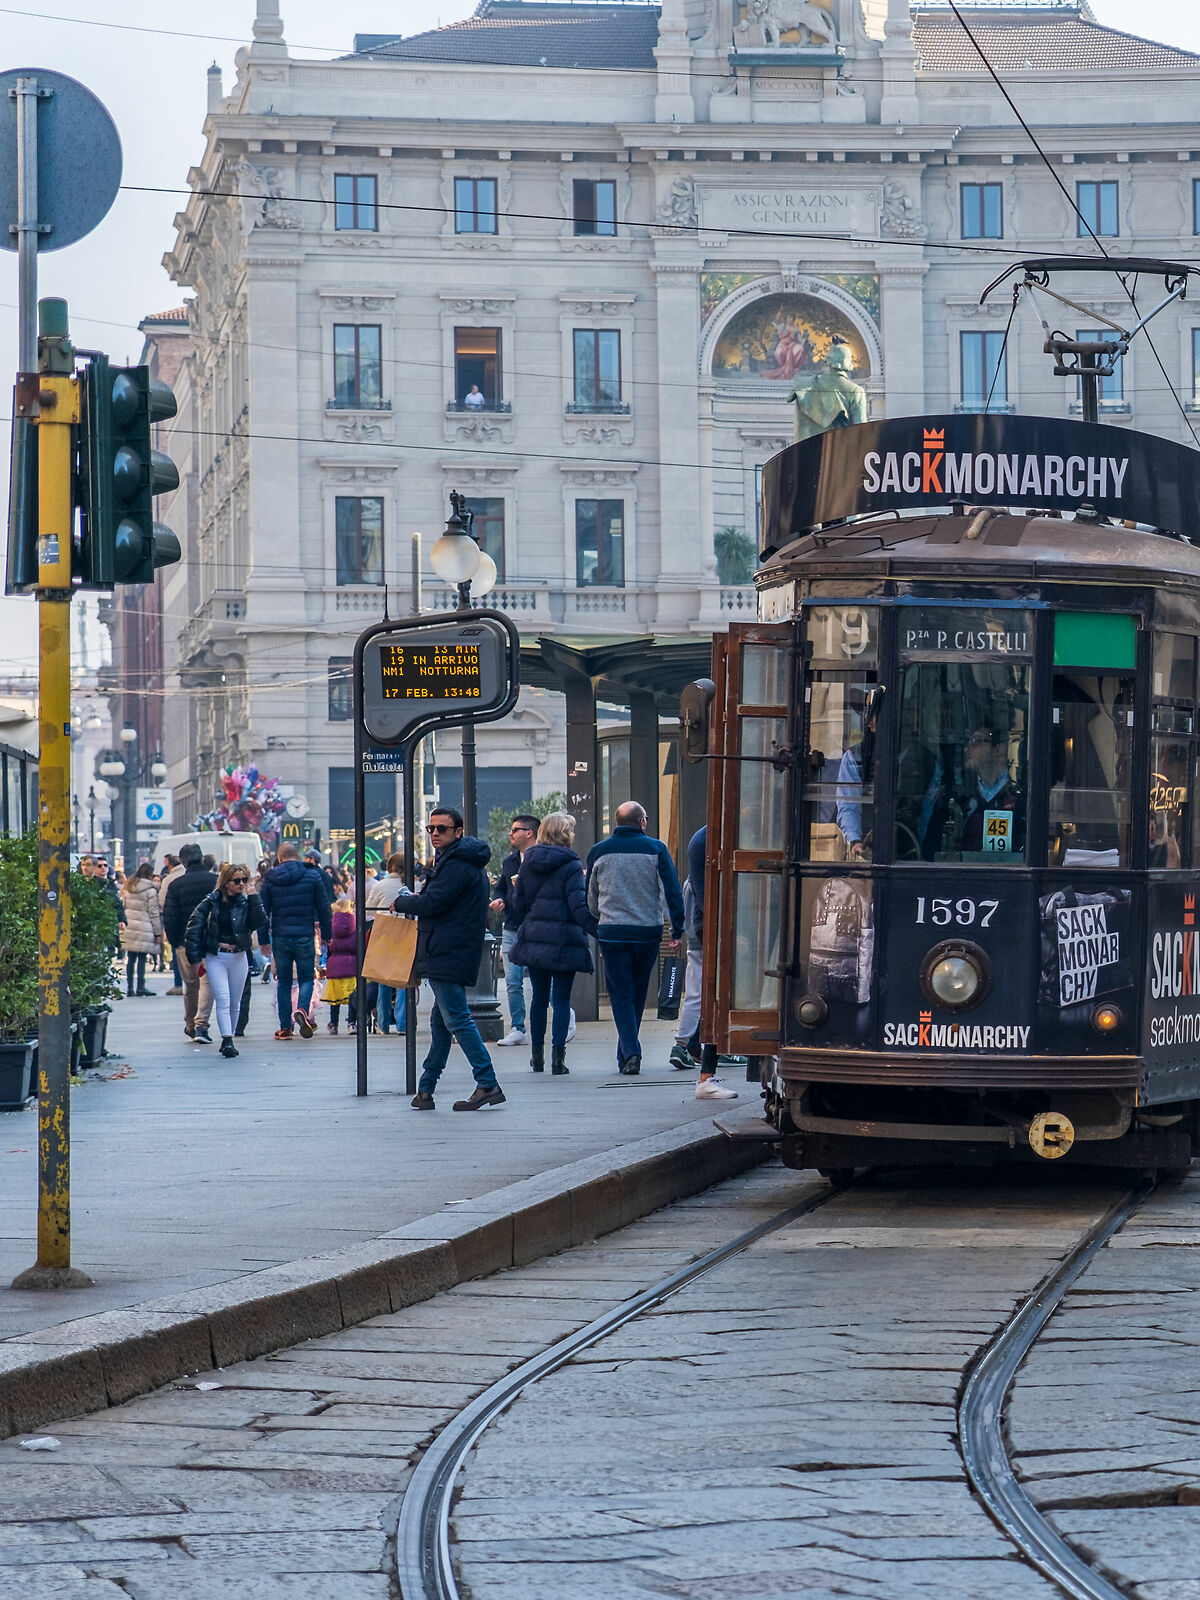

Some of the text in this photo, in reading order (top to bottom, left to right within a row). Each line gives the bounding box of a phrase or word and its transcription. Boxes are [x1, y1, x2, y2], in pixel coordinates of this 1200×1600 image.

[731, 194, 848, 207] ASSICVRAZIONI
[752, 211, 827, 223] GENERALI
[863, 451, 1129, 499] SACKMONARCHY
[815, 606, 871, 655] 19
[937, 630, 948, 649] P.
[954, 631, 1026, 651] CASTELLI
[390, 646, 478, 654] 16 13 MIN
[391, 655, 479, 665] 19 IN ARRIVO
[383, 666, 479, 676] NM1 NOTTURNA
[385, 688, 480, 698] 17 FEB. 13:48
[988, 819, 1007, 835] 45
[988, 837, 1006, 851] 19
[915, 897, 1000, 928] 1597
[1058, 906, 1106, 940] SACK
[1058, 934, 1119, 971] MONAR
[1061, 969, 1096, 1003] CHY
[884, 1022, 1031, 1048] SACKMONARCHY
